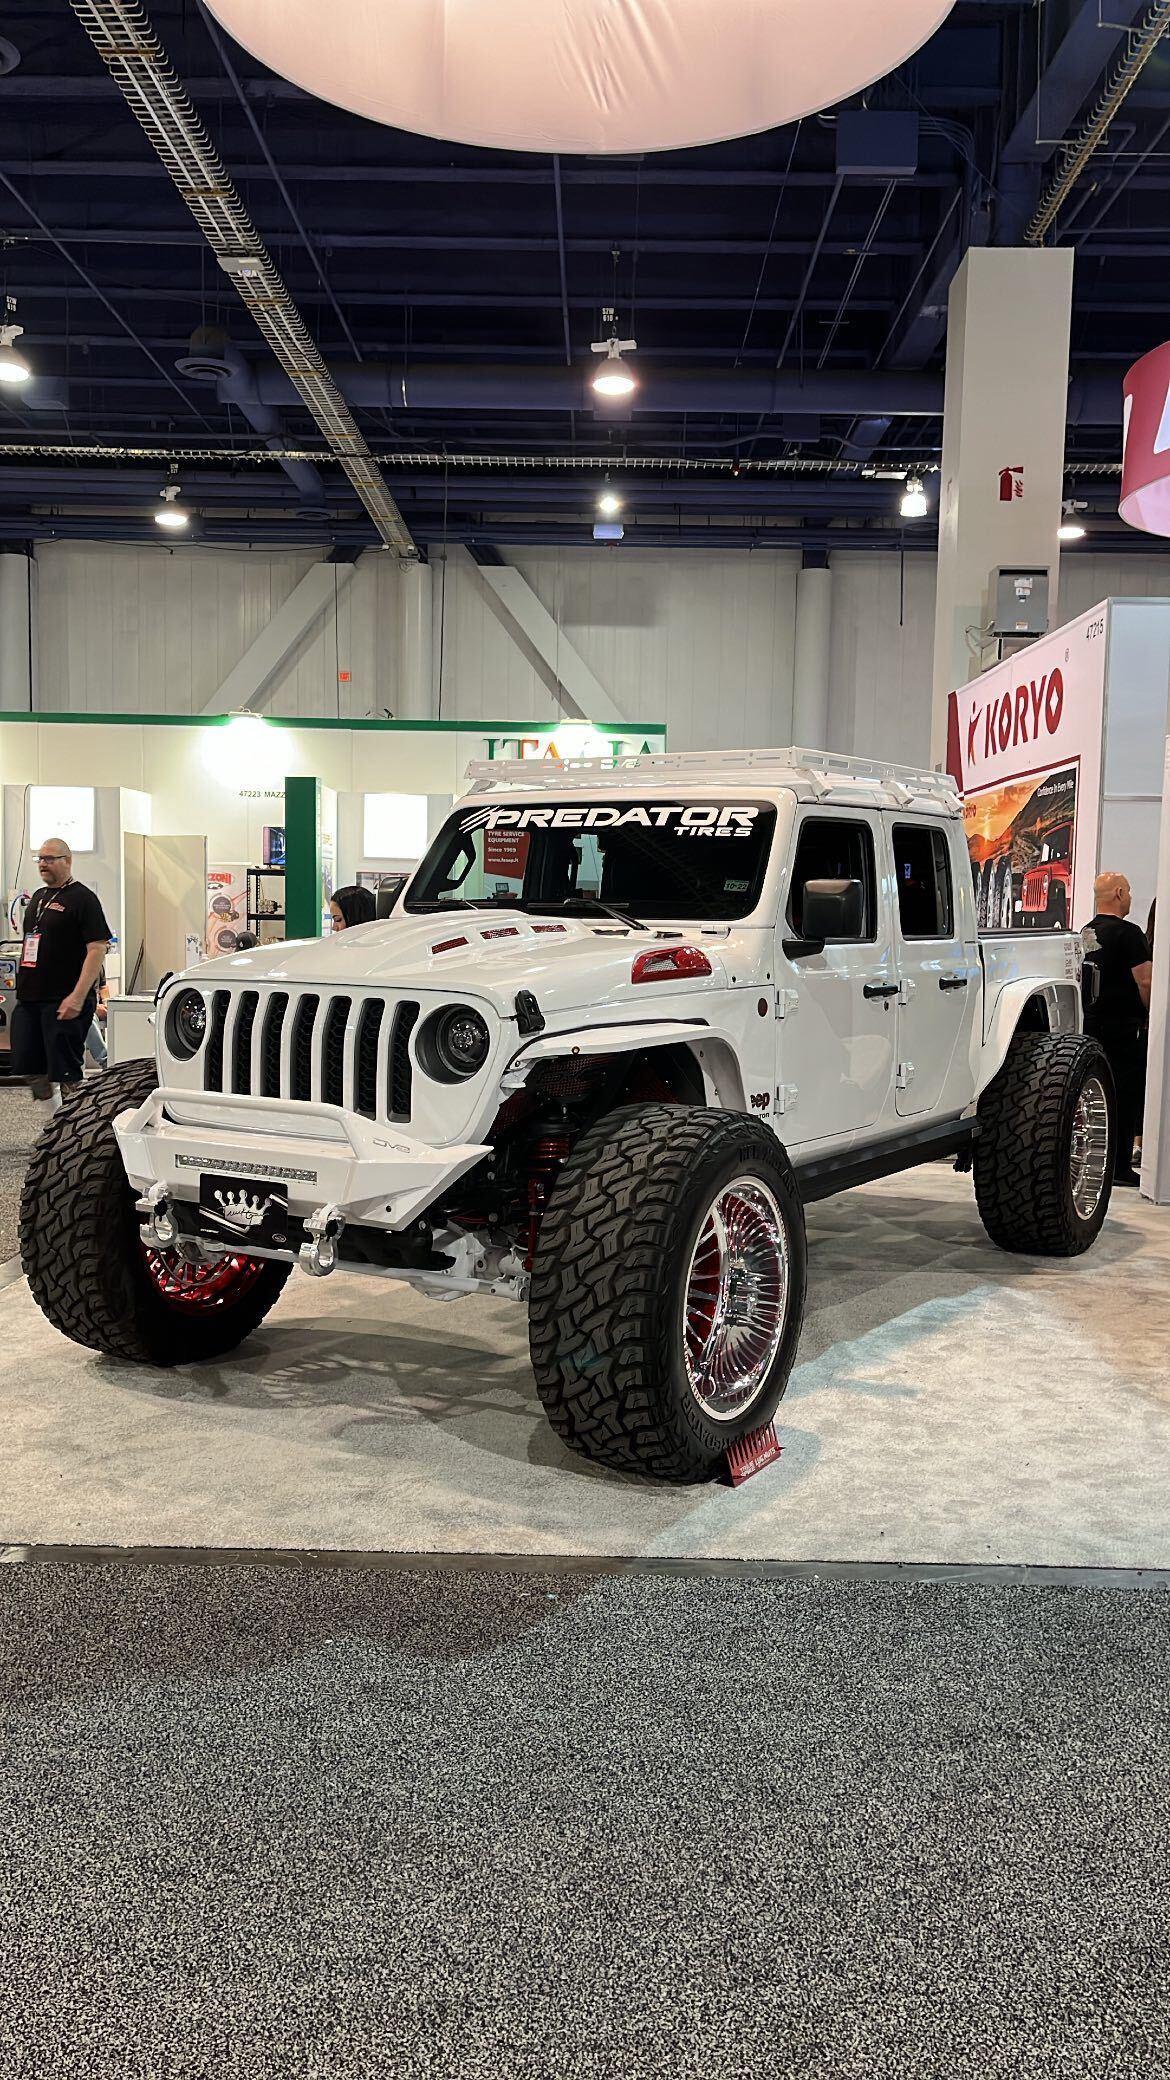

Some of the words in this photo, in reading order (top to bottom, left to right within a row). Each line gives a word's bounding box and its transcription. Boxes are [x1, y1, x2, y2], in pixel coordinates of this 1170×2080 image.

[984, 668, 1063, 759] KORYO
[239, 790, 261, 798] 47223
[485, 806, 759, 829] PREDATOR
[673, 826, 753, 838] TIRES
